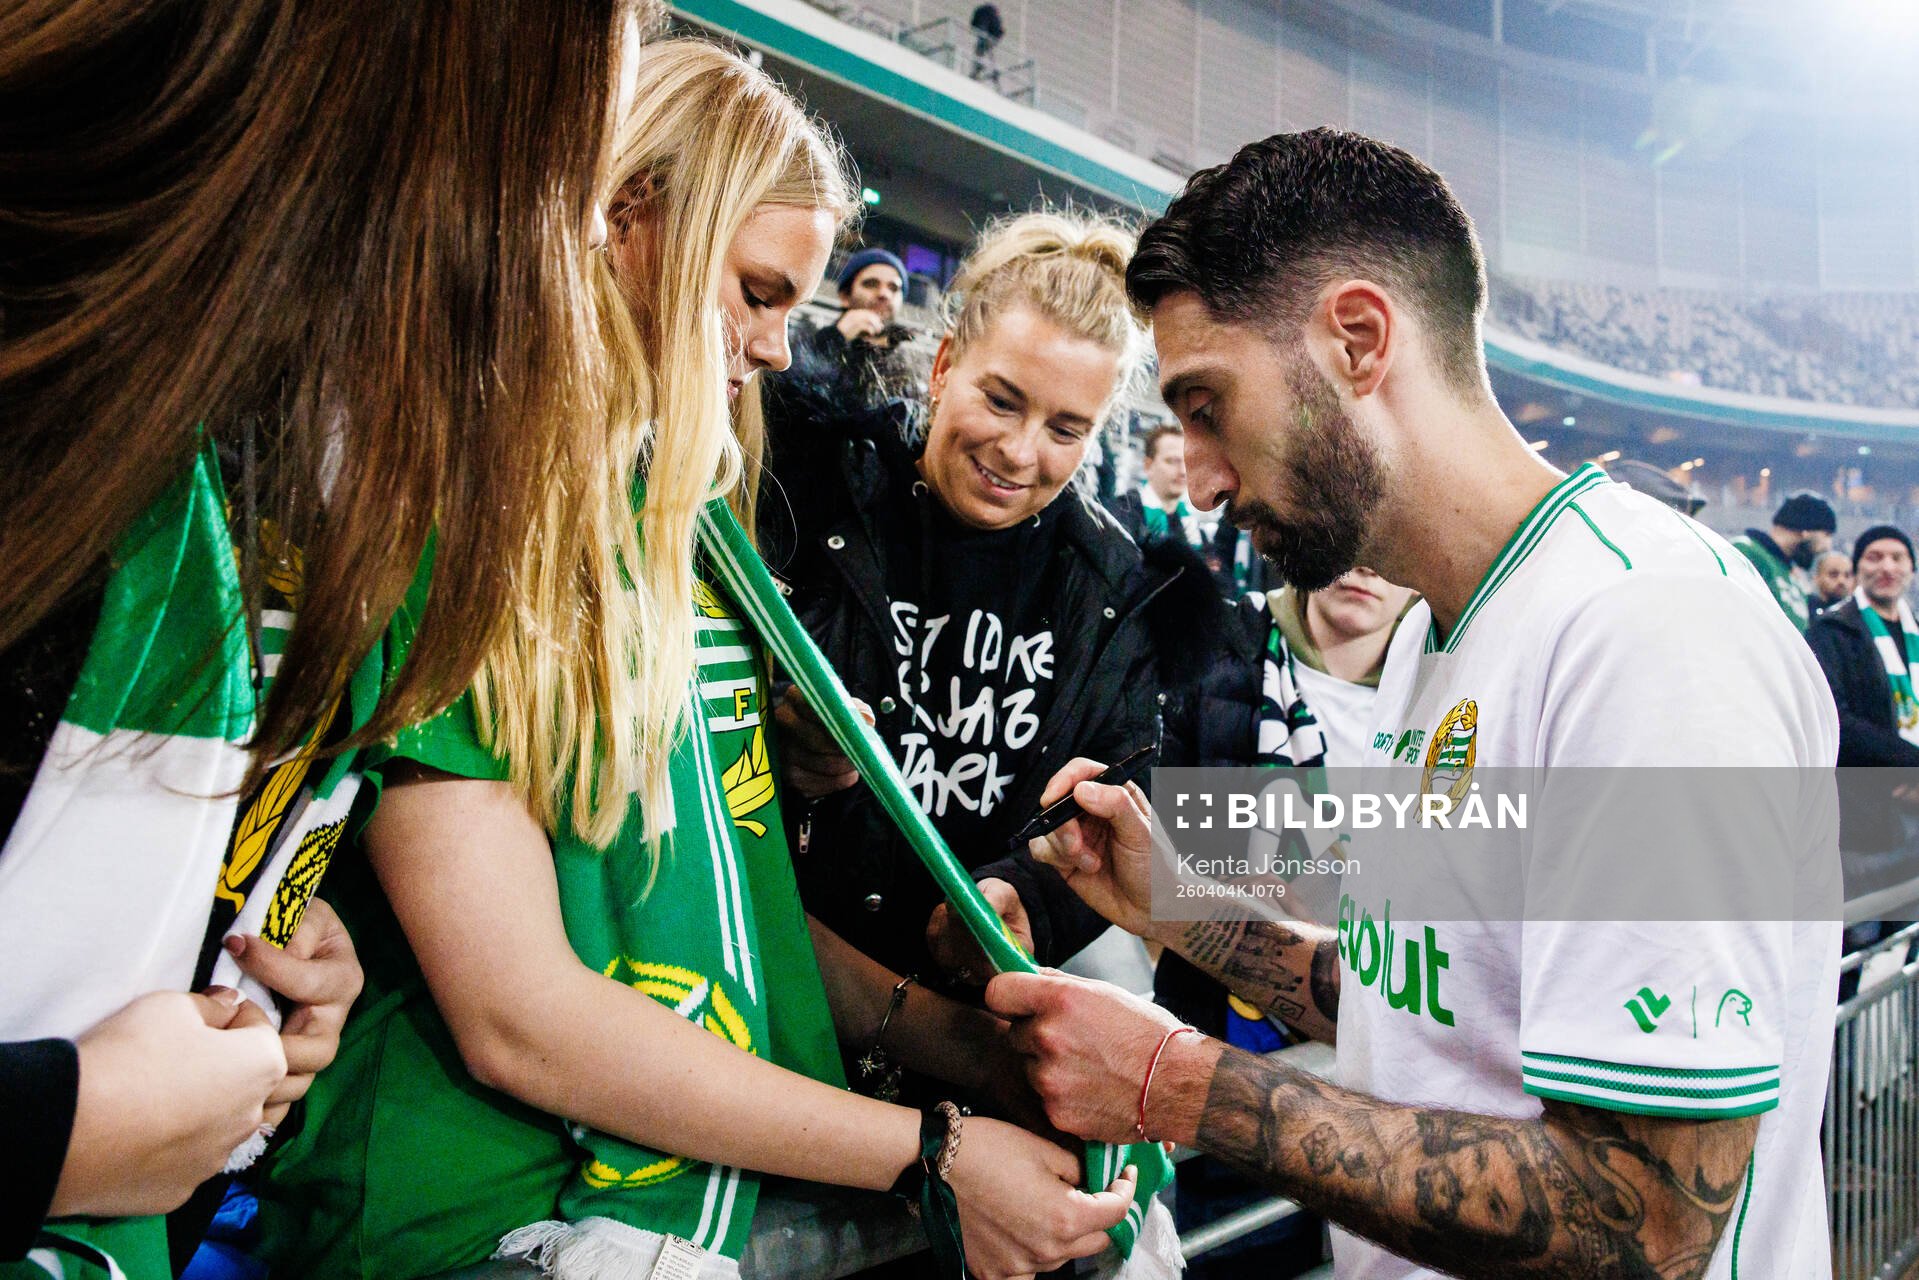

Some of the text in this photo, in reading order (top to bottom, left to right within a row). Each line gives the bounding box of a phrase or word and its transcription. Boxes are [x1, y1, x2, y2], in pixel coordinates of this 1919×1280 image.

[734, 687, 751, 722] F
[900, 733, 1017, 818] TARK
[1338, 893, 1455, 1027] evolut
